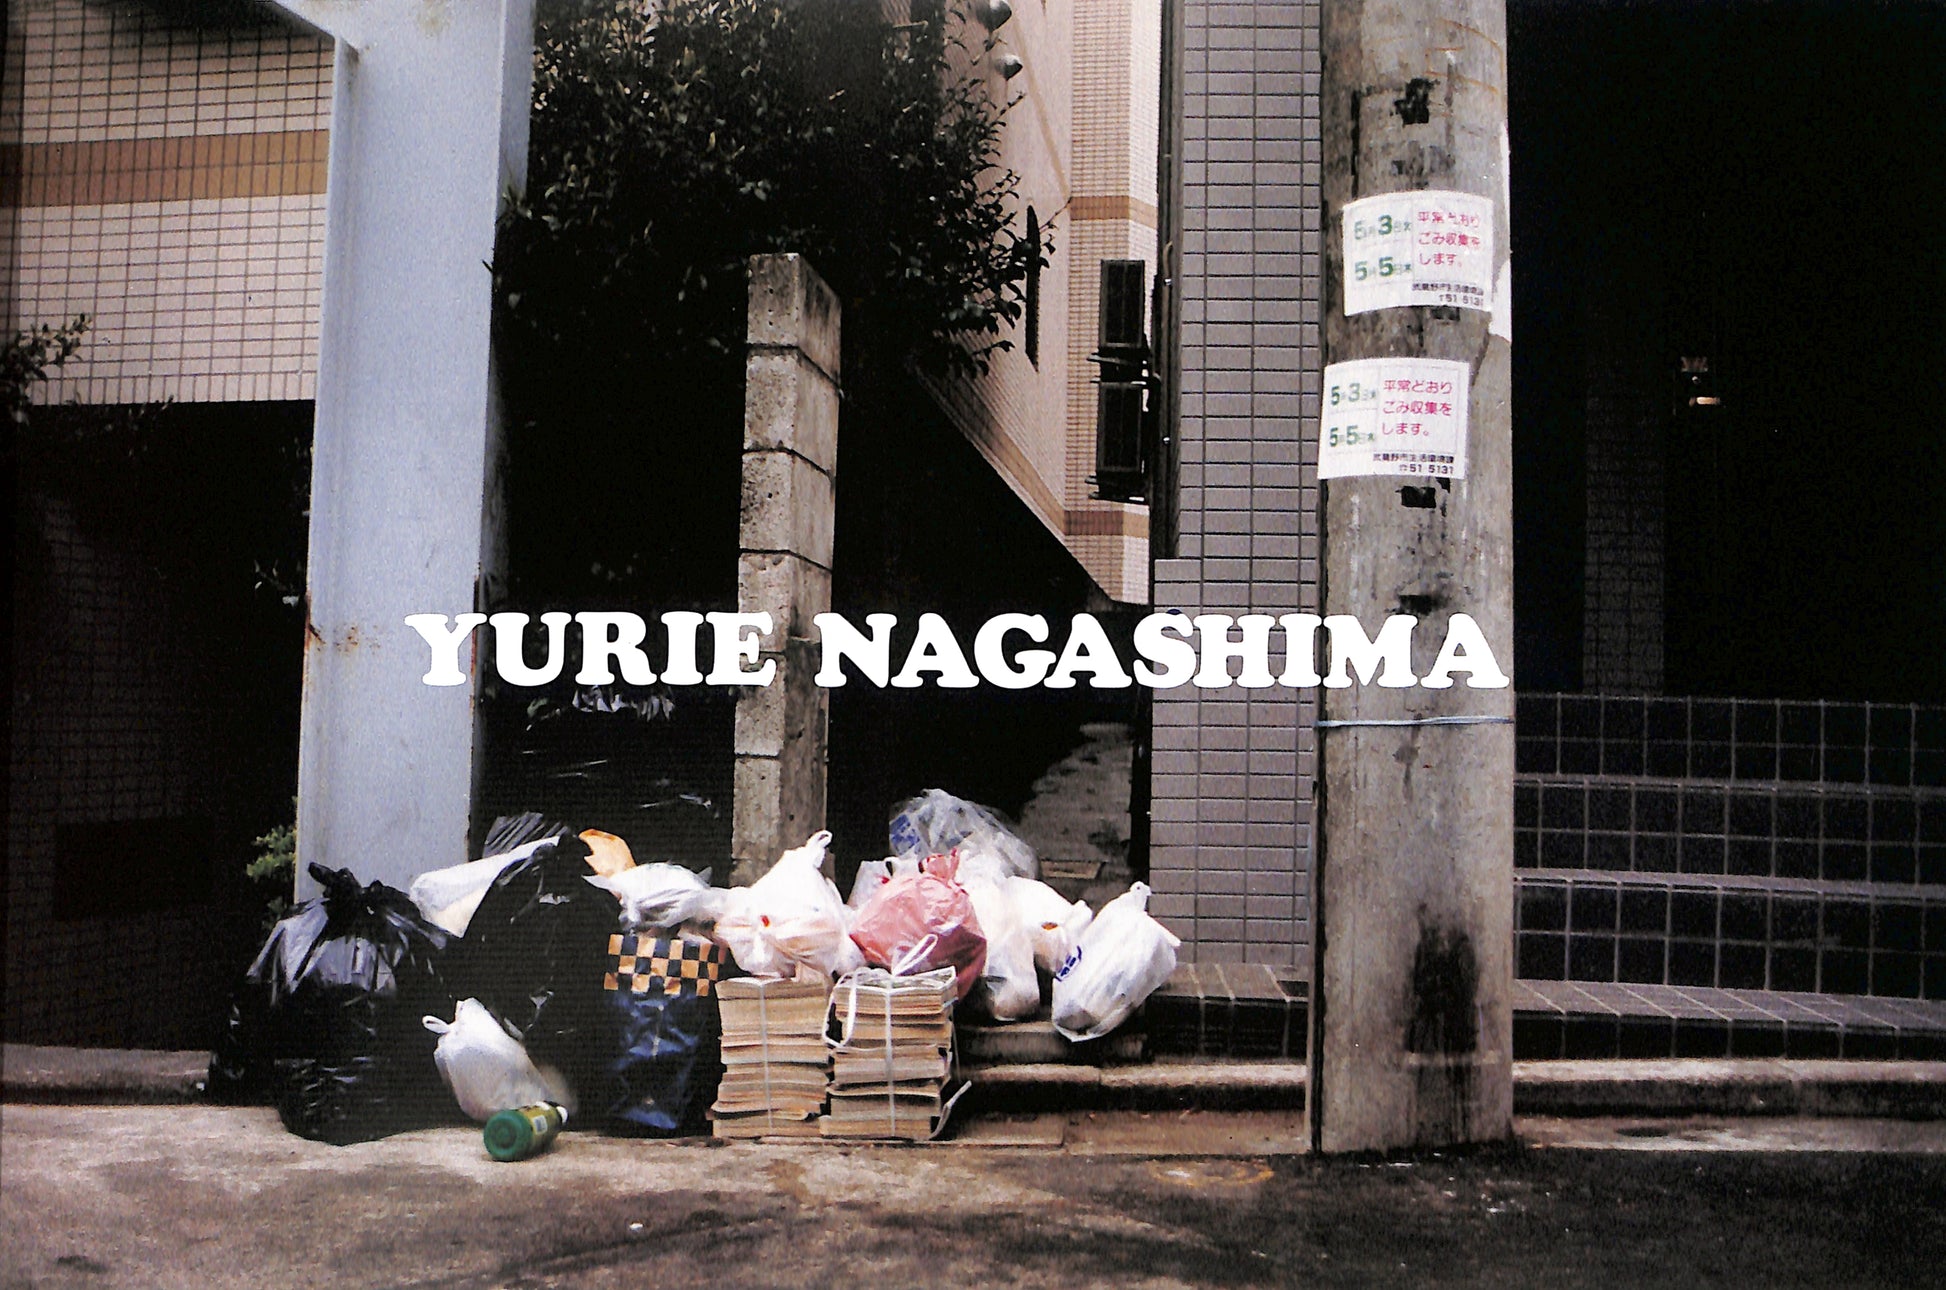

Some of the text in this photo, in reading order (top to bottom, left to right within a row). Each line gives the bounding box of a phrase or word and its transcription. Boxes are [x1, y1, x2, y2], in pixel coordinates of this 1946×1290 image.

[1383, 400, 1453, 417] ごみ収集を
